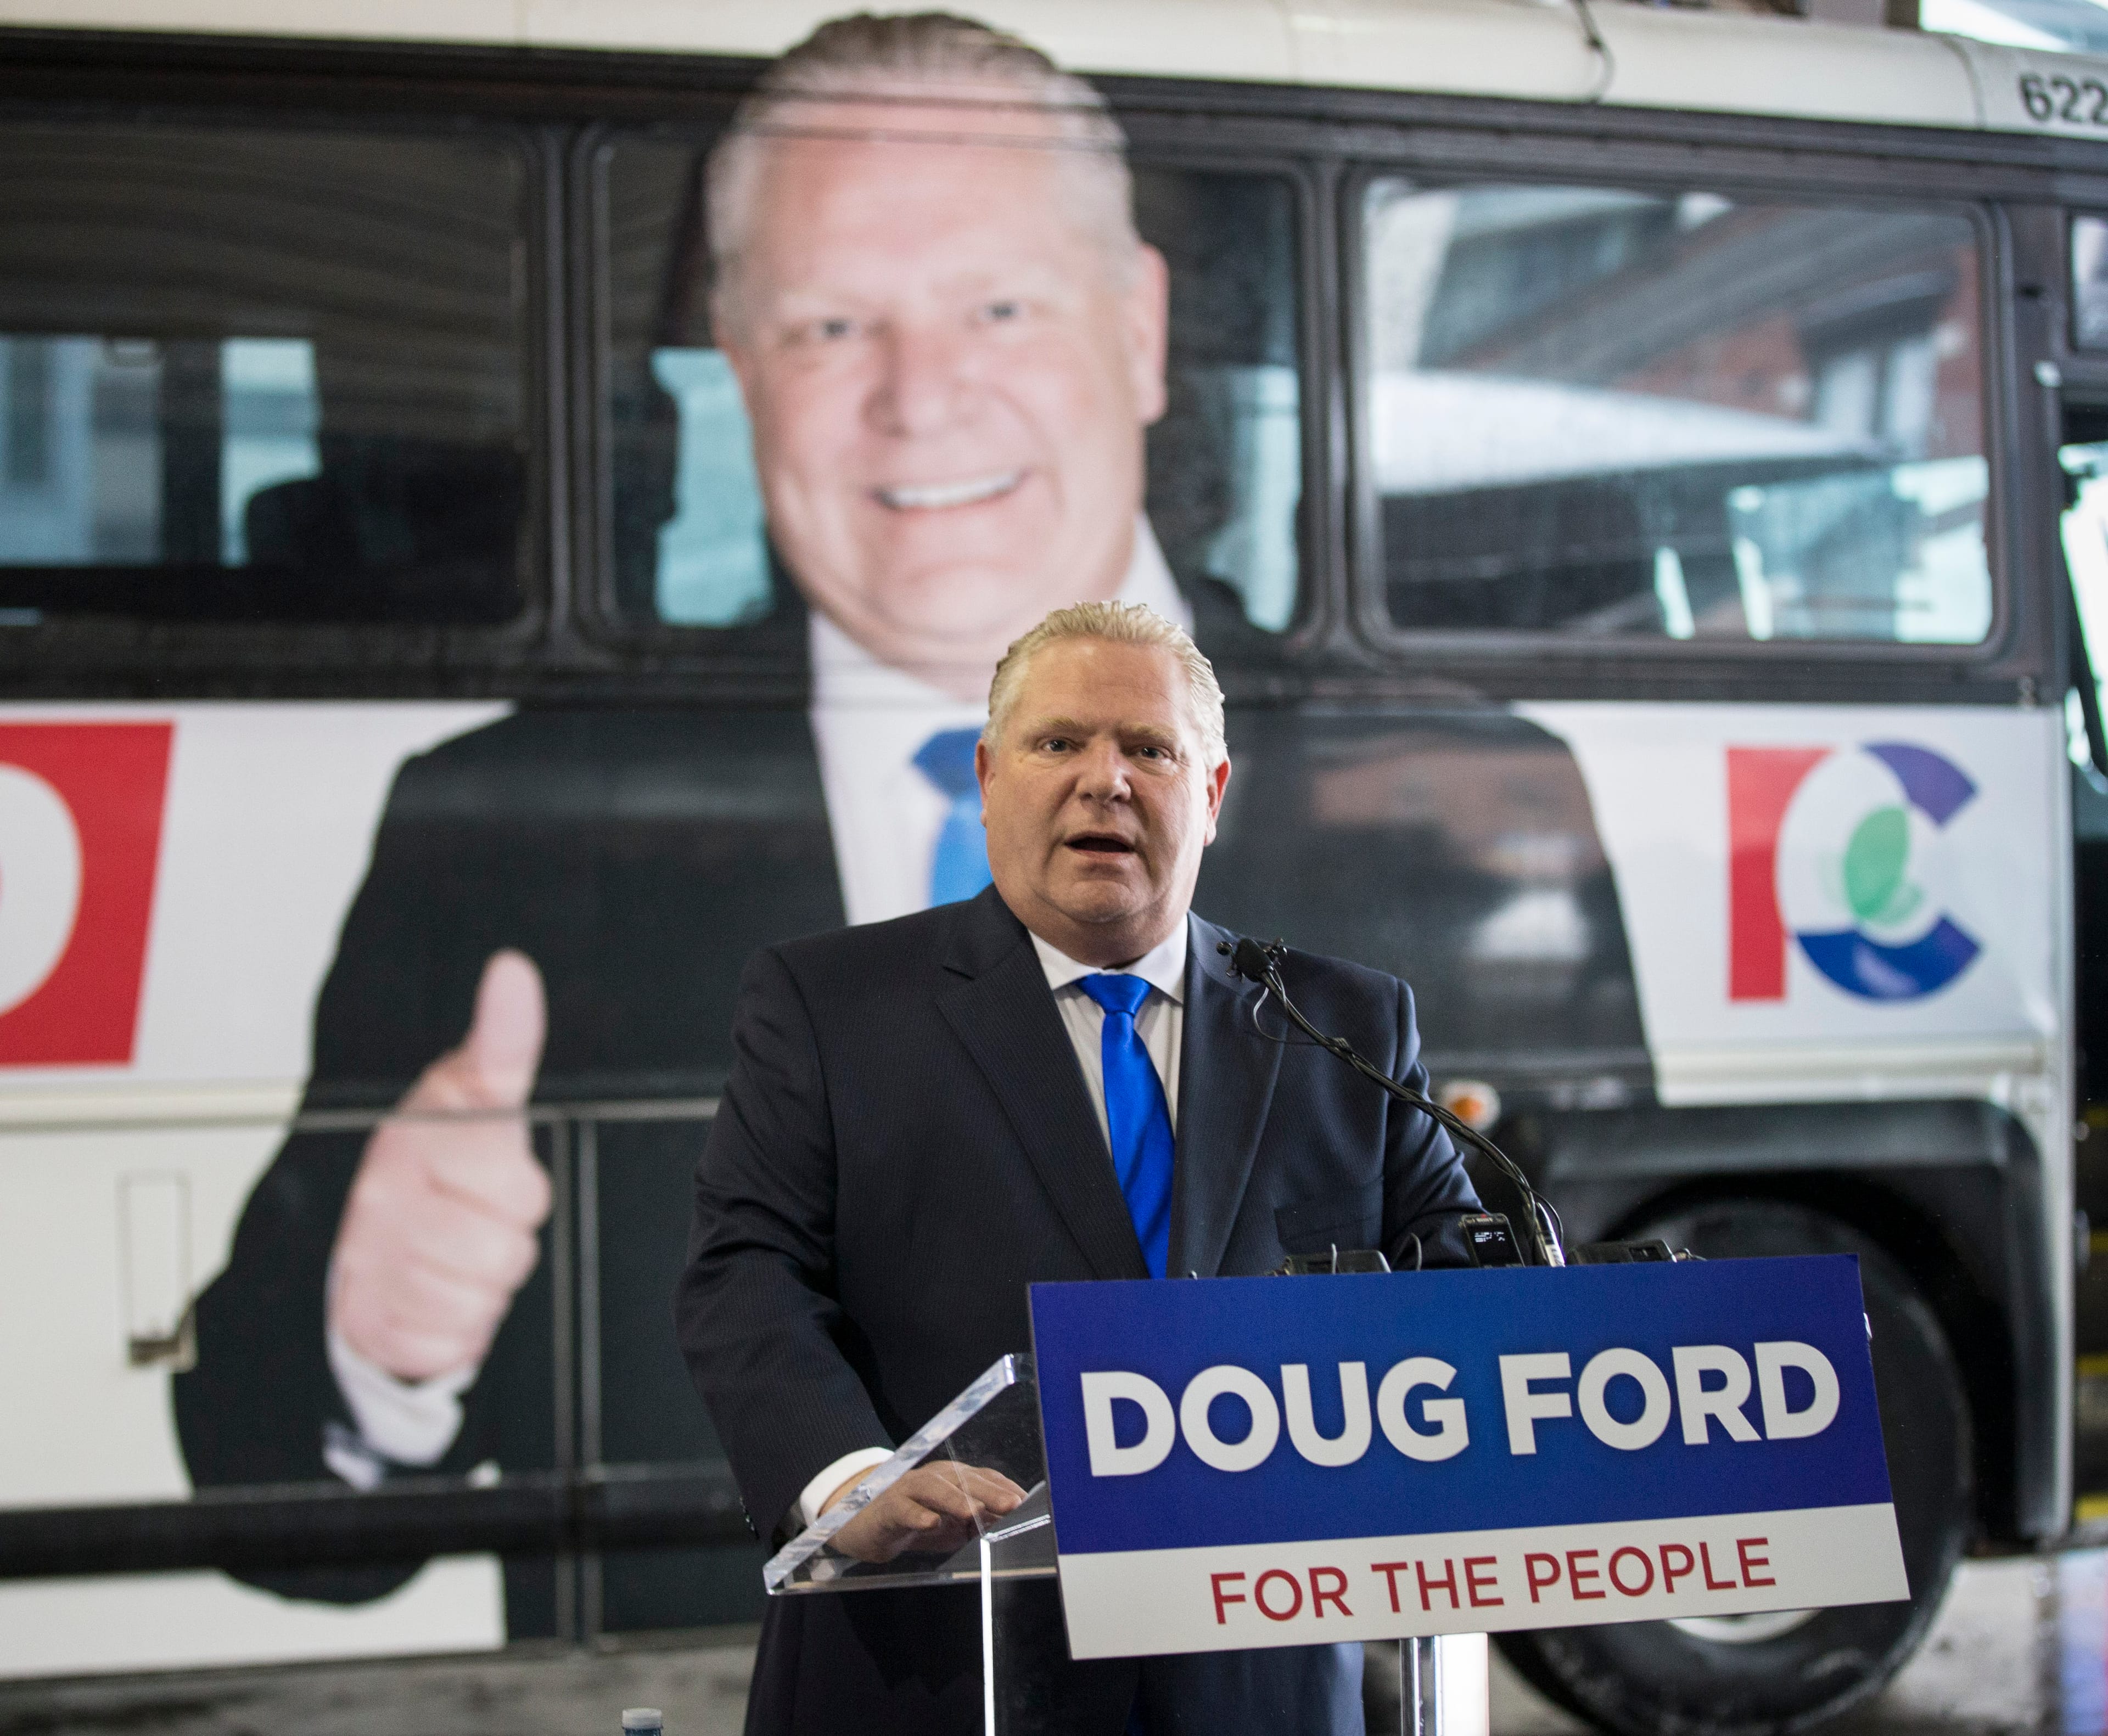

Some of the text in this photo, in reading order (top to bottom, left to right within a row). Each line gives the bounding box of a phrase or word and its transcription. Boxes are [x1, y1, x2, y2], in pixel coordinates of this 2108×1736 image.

[2017, 72, 2108, 125] 622
[1080, 1341, 1840, 1477] DOUG FORD
[1210, 1537, 1776, 1625] FOR THE PEOPLE
